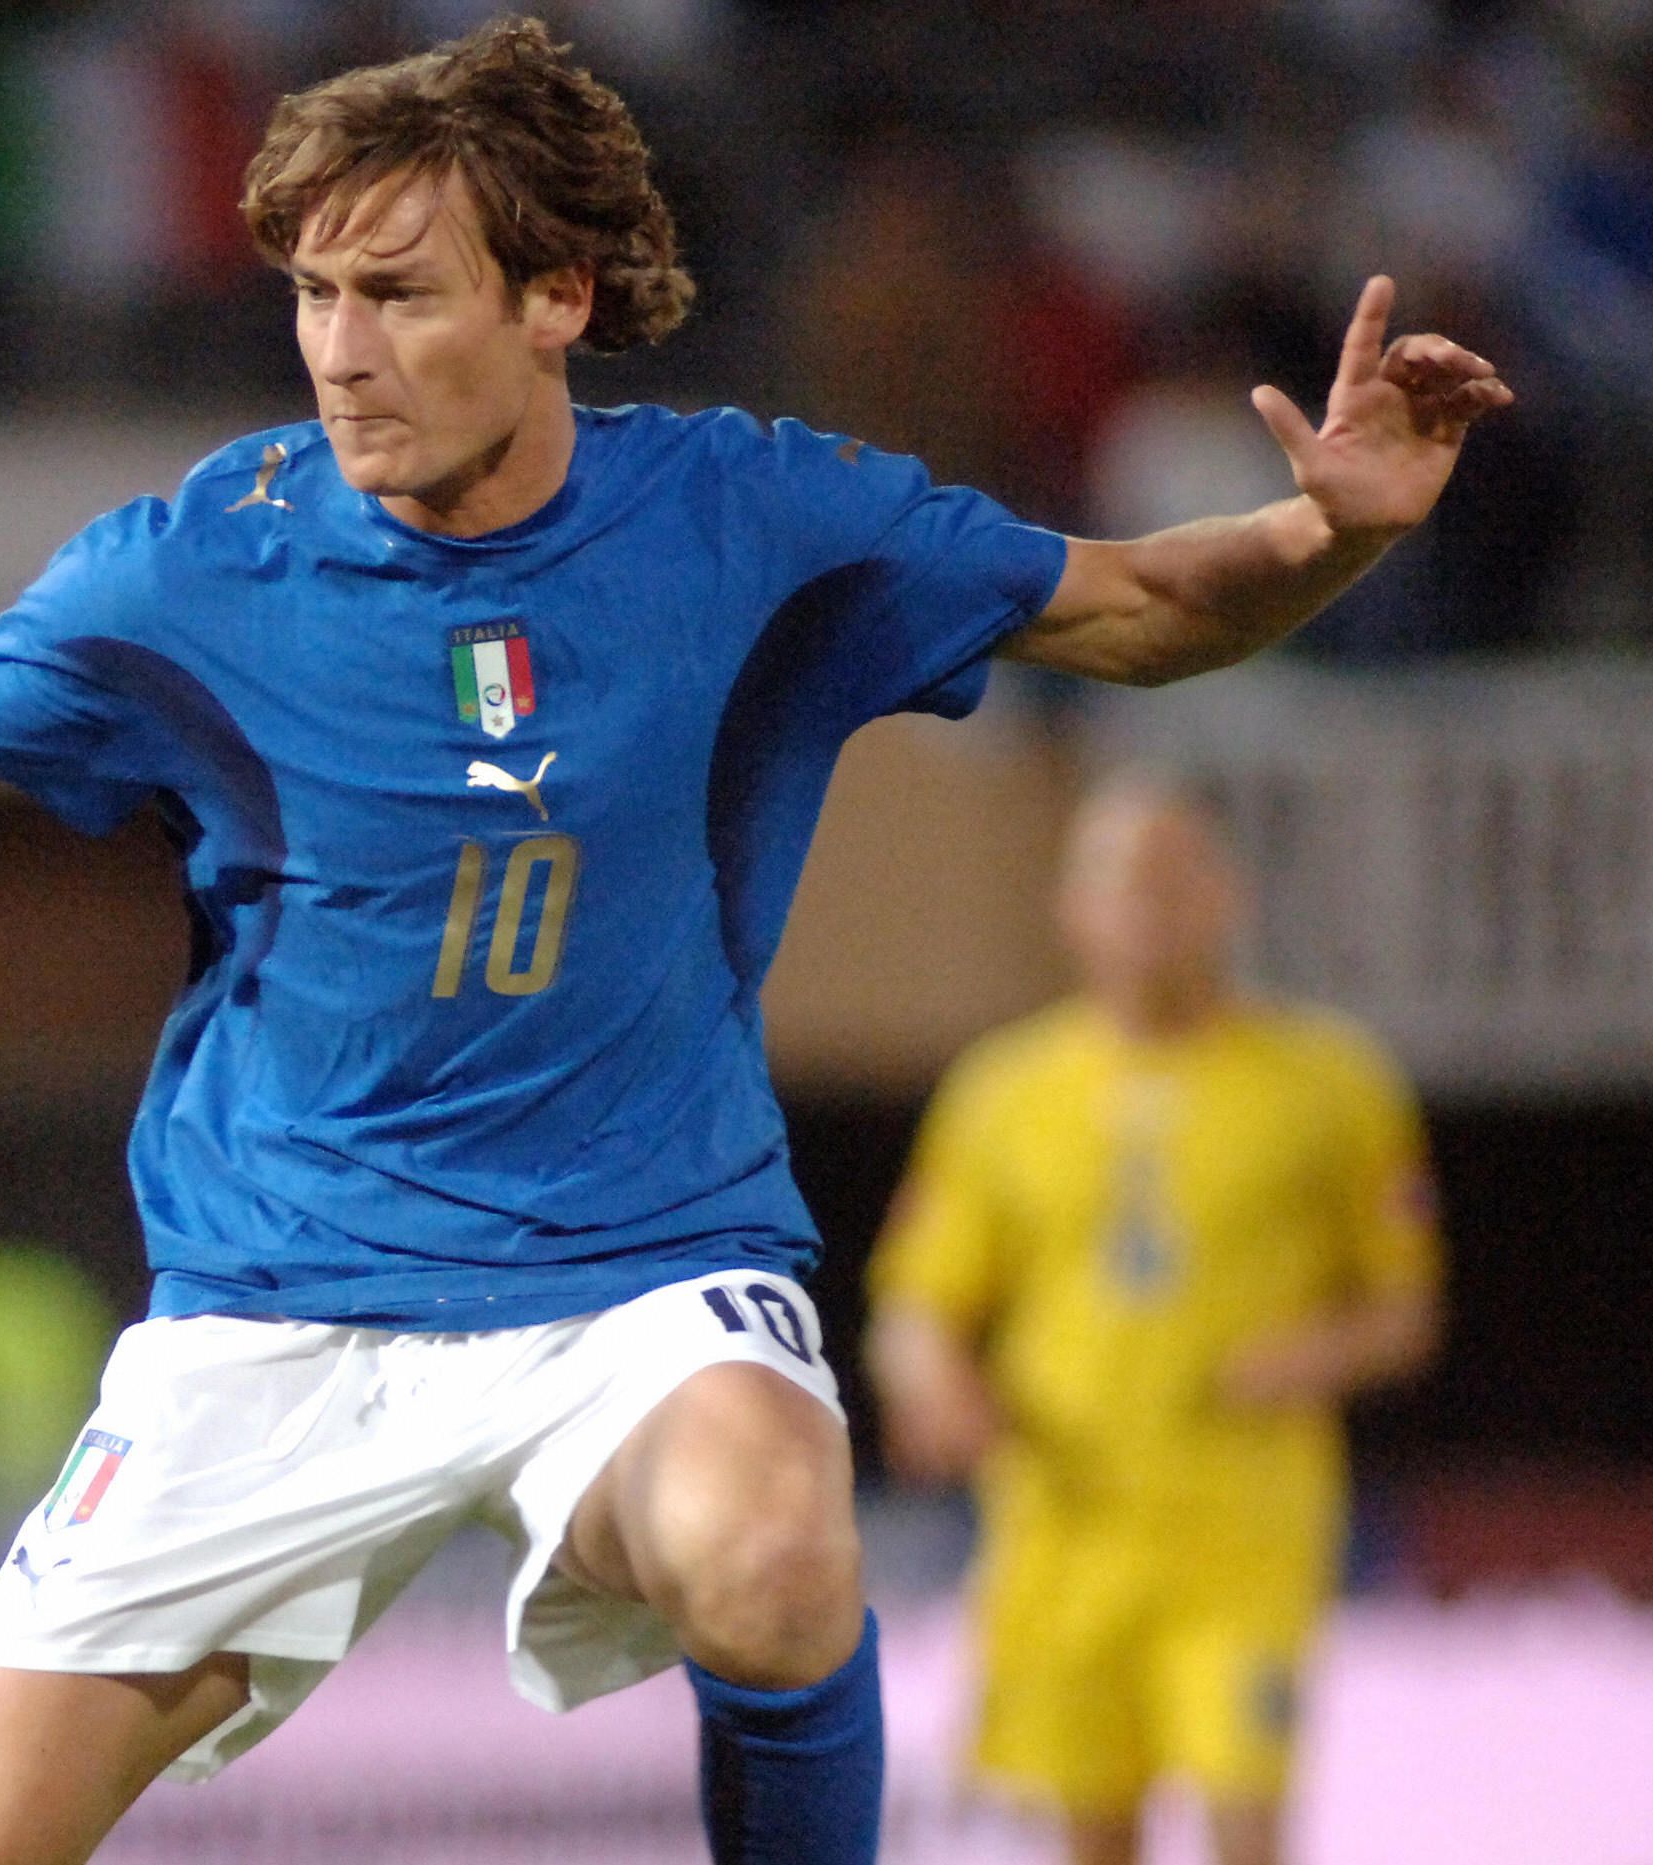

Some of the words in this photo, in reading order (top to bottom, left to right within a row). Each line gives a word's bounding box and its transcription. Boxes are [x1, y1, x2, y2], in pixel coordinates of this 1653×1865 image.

[453, 623, 519, 643] ITALIA
[433, 837, 579, 998] 10
[701, 1284, 812, 1364] 10
